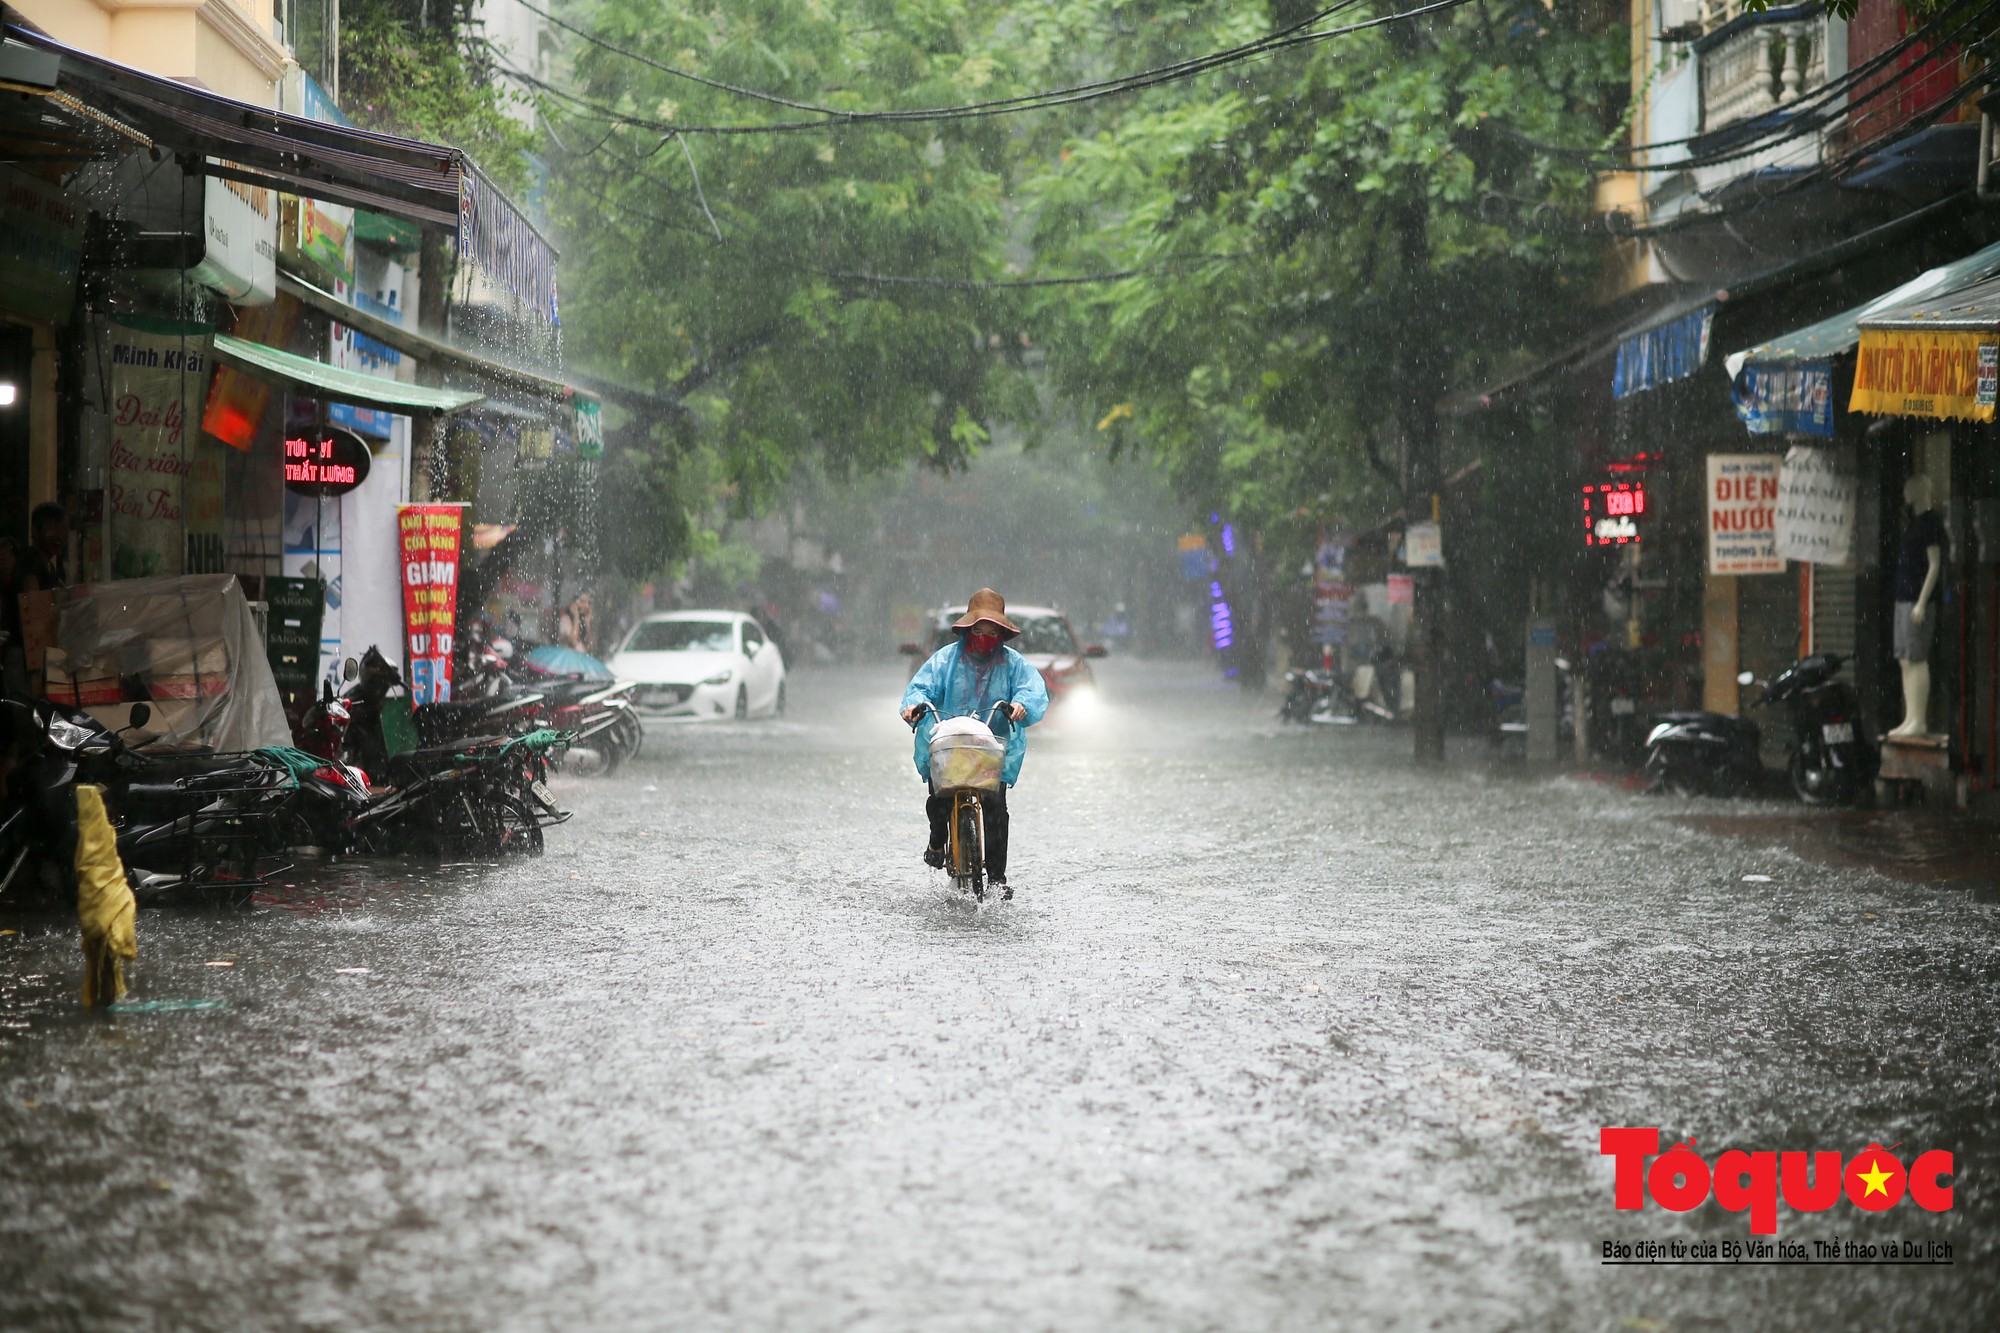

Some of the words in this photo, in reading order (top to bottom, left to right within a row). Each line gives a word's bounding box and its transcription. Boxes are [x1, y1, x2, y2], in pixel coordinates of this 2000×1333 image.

[113, 344, 158, 367] Minh
[163, 350, 204, 372] Khải
[285, 437, 307, 457] TÚI
[320, 439, 333, 458] VÍ
[285, 459, 317, 481] THẮT
[320, 464, 354, 483] LƯNG
[1715, 473, 1778, 502] ĐIỆN
[147, 488, 181, 520] Tre
[406, 550, 455, 585] GIẢM
[274, 596, 313, 606] SAIGON
[270, 634, 309, 644] SAIGON
